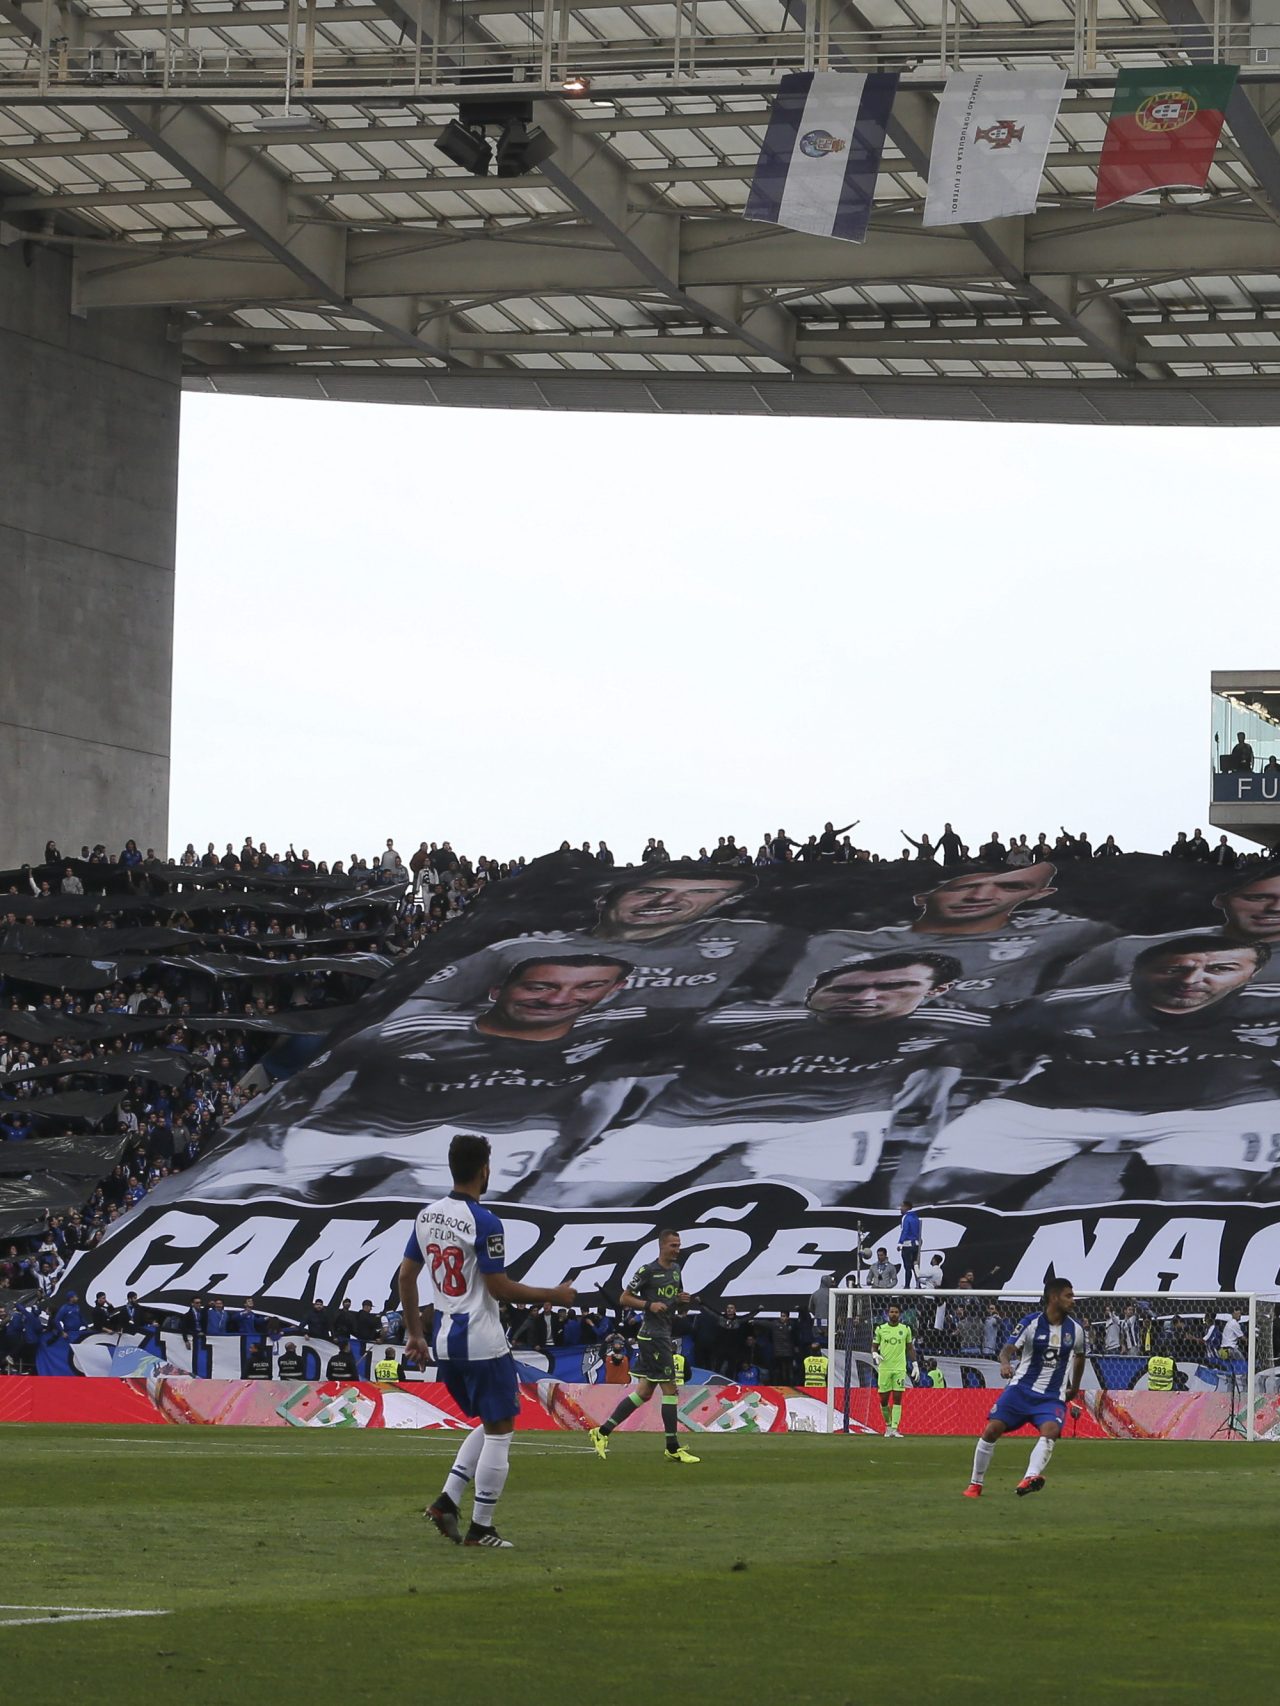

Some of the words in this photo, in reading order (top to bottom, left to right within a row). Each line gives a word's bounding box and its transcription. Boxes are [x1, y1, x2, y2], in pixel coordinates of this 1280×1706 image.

[957, 112, 972, 162] PORTUGUESA
[955, 164, 962, 176] DE
[951, 178, 961, 214] FUTEBOL
[426, 1243, 467, 1297] 28
[657, 1284, 679, 1299] NOS
[885, 1337, 902, 1346] NOS
[808, 1364, 821, 1373] 034
[1152, 1366, 1166, 1376] 293
